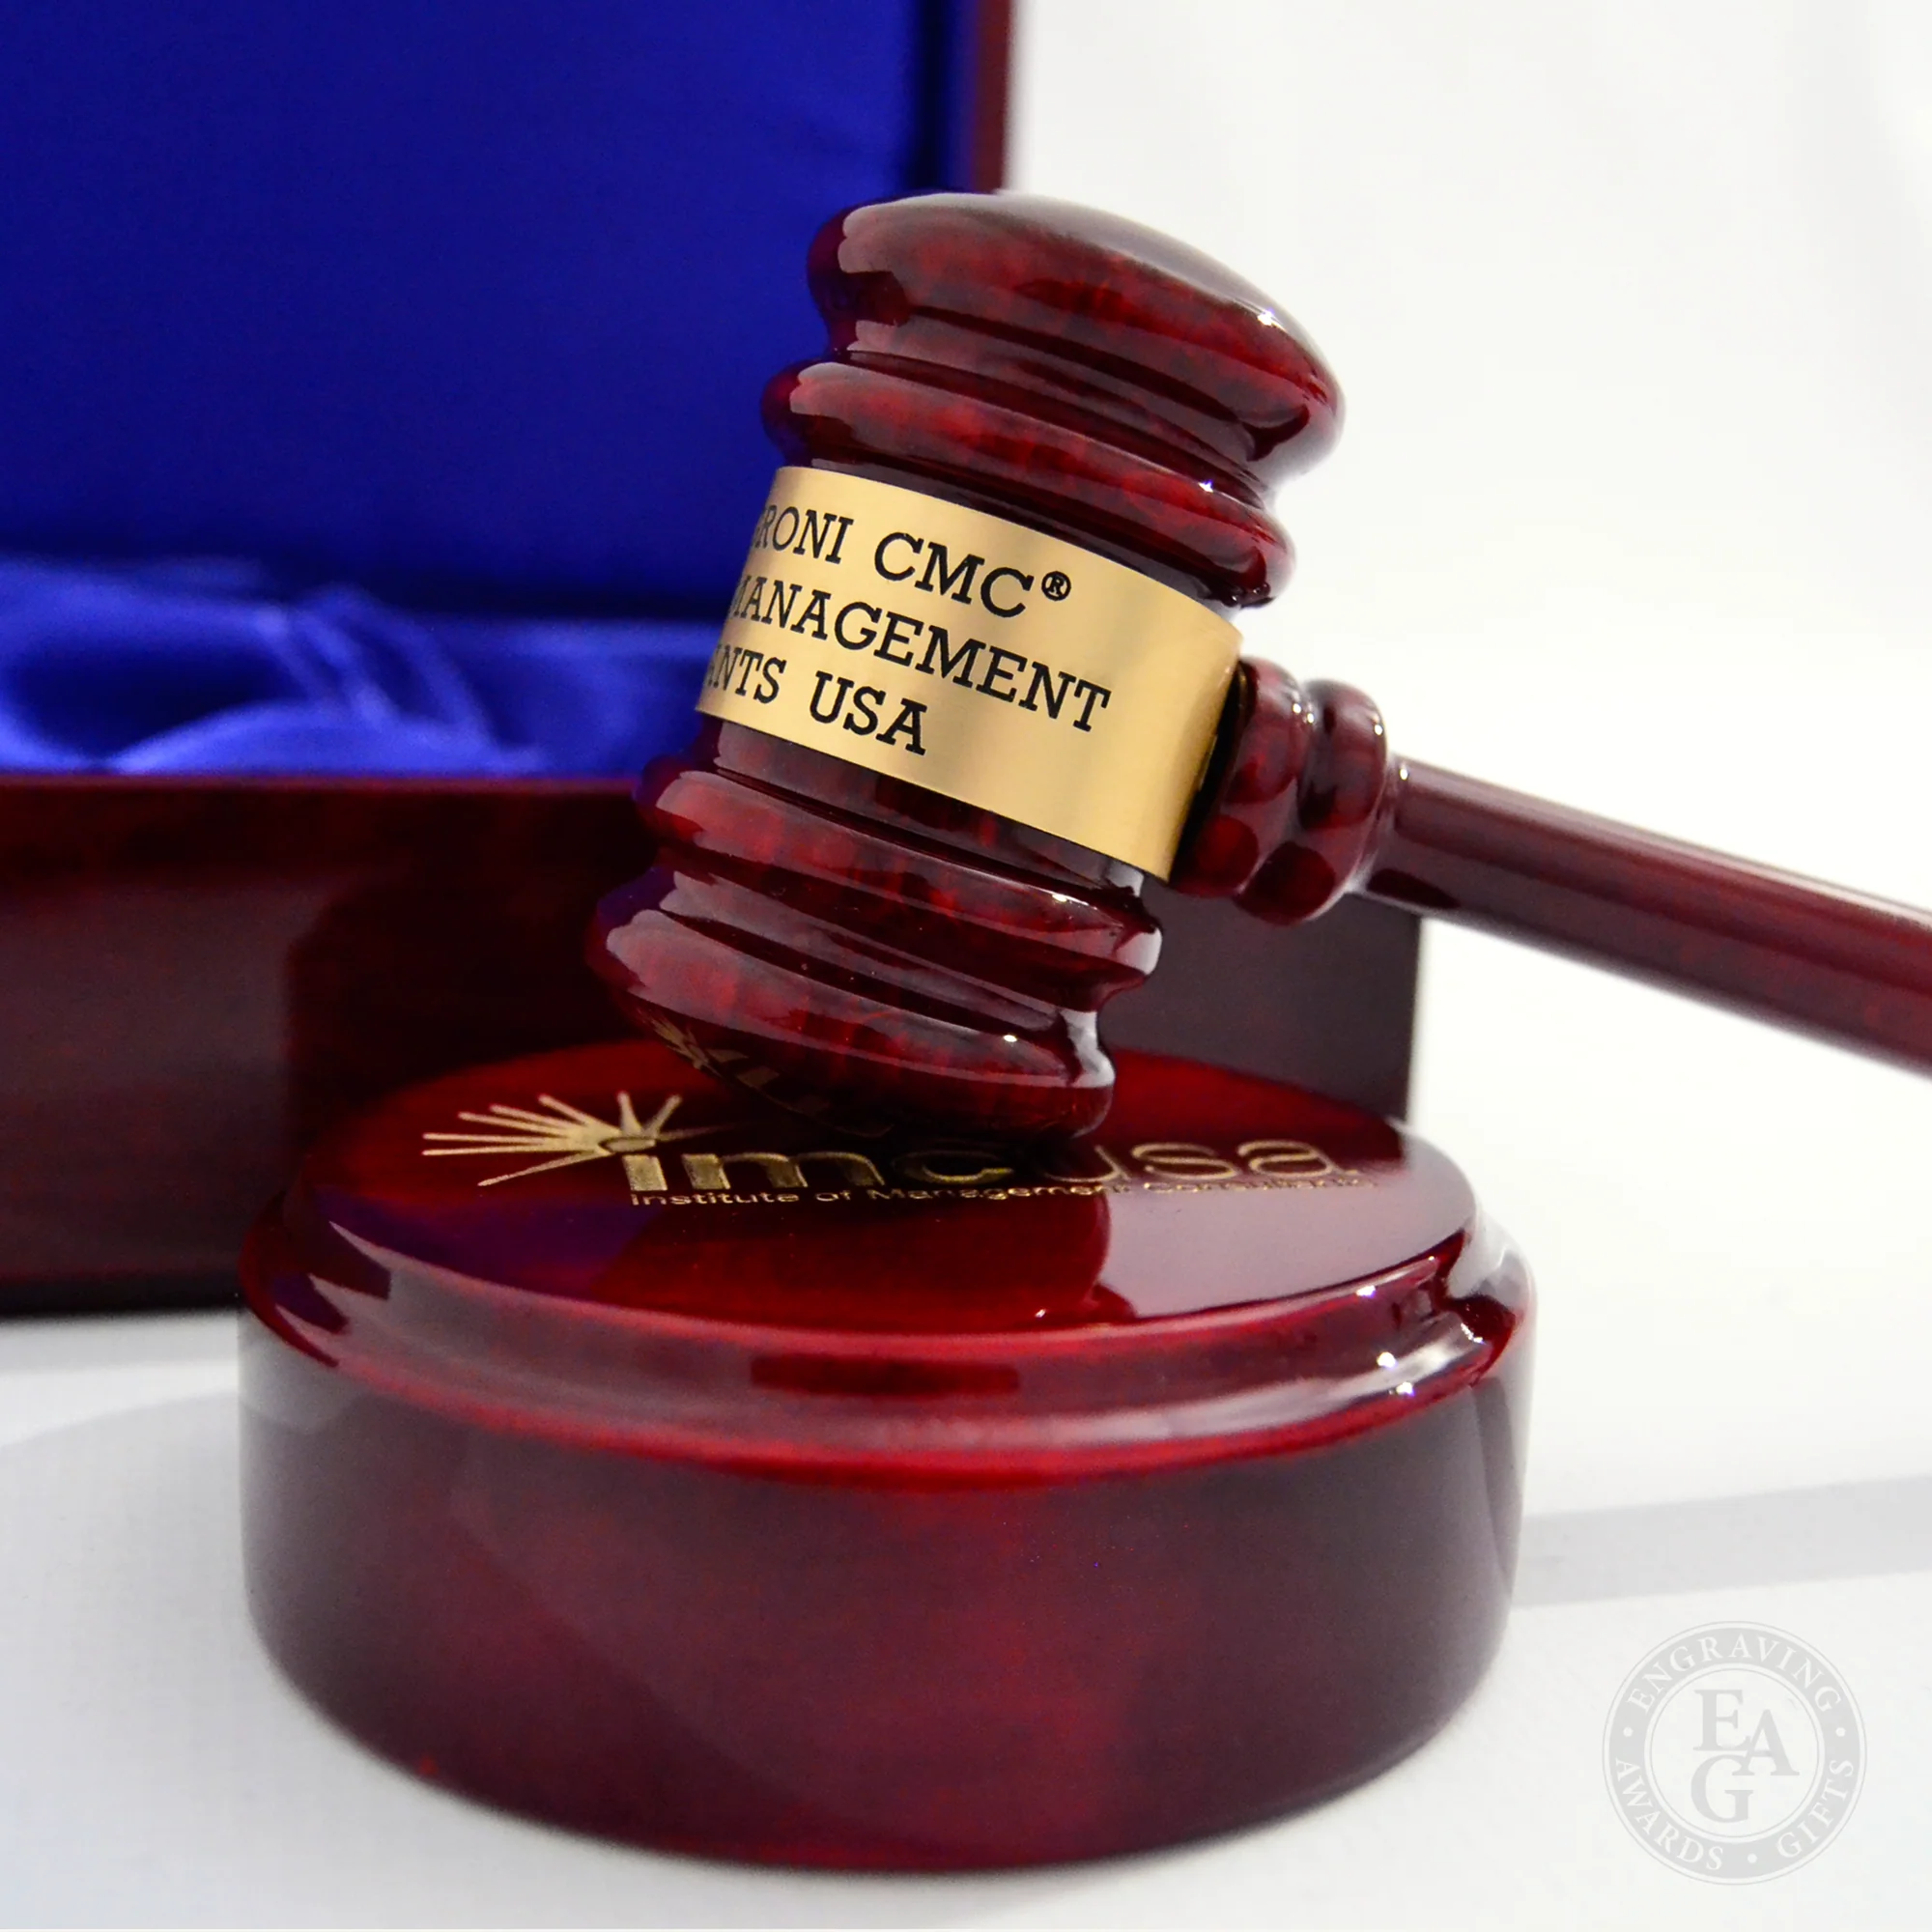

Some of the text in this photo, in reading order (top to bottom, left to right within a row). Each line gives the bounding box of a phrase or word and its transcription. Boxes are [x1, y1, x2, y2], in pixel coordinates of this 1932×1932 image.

[753, 505, 854, 564] RONI
[810, 670, 927, 755] USA
[630, 1190, 800, 1206] Institute
[813, 1188, 854, 1203] of
